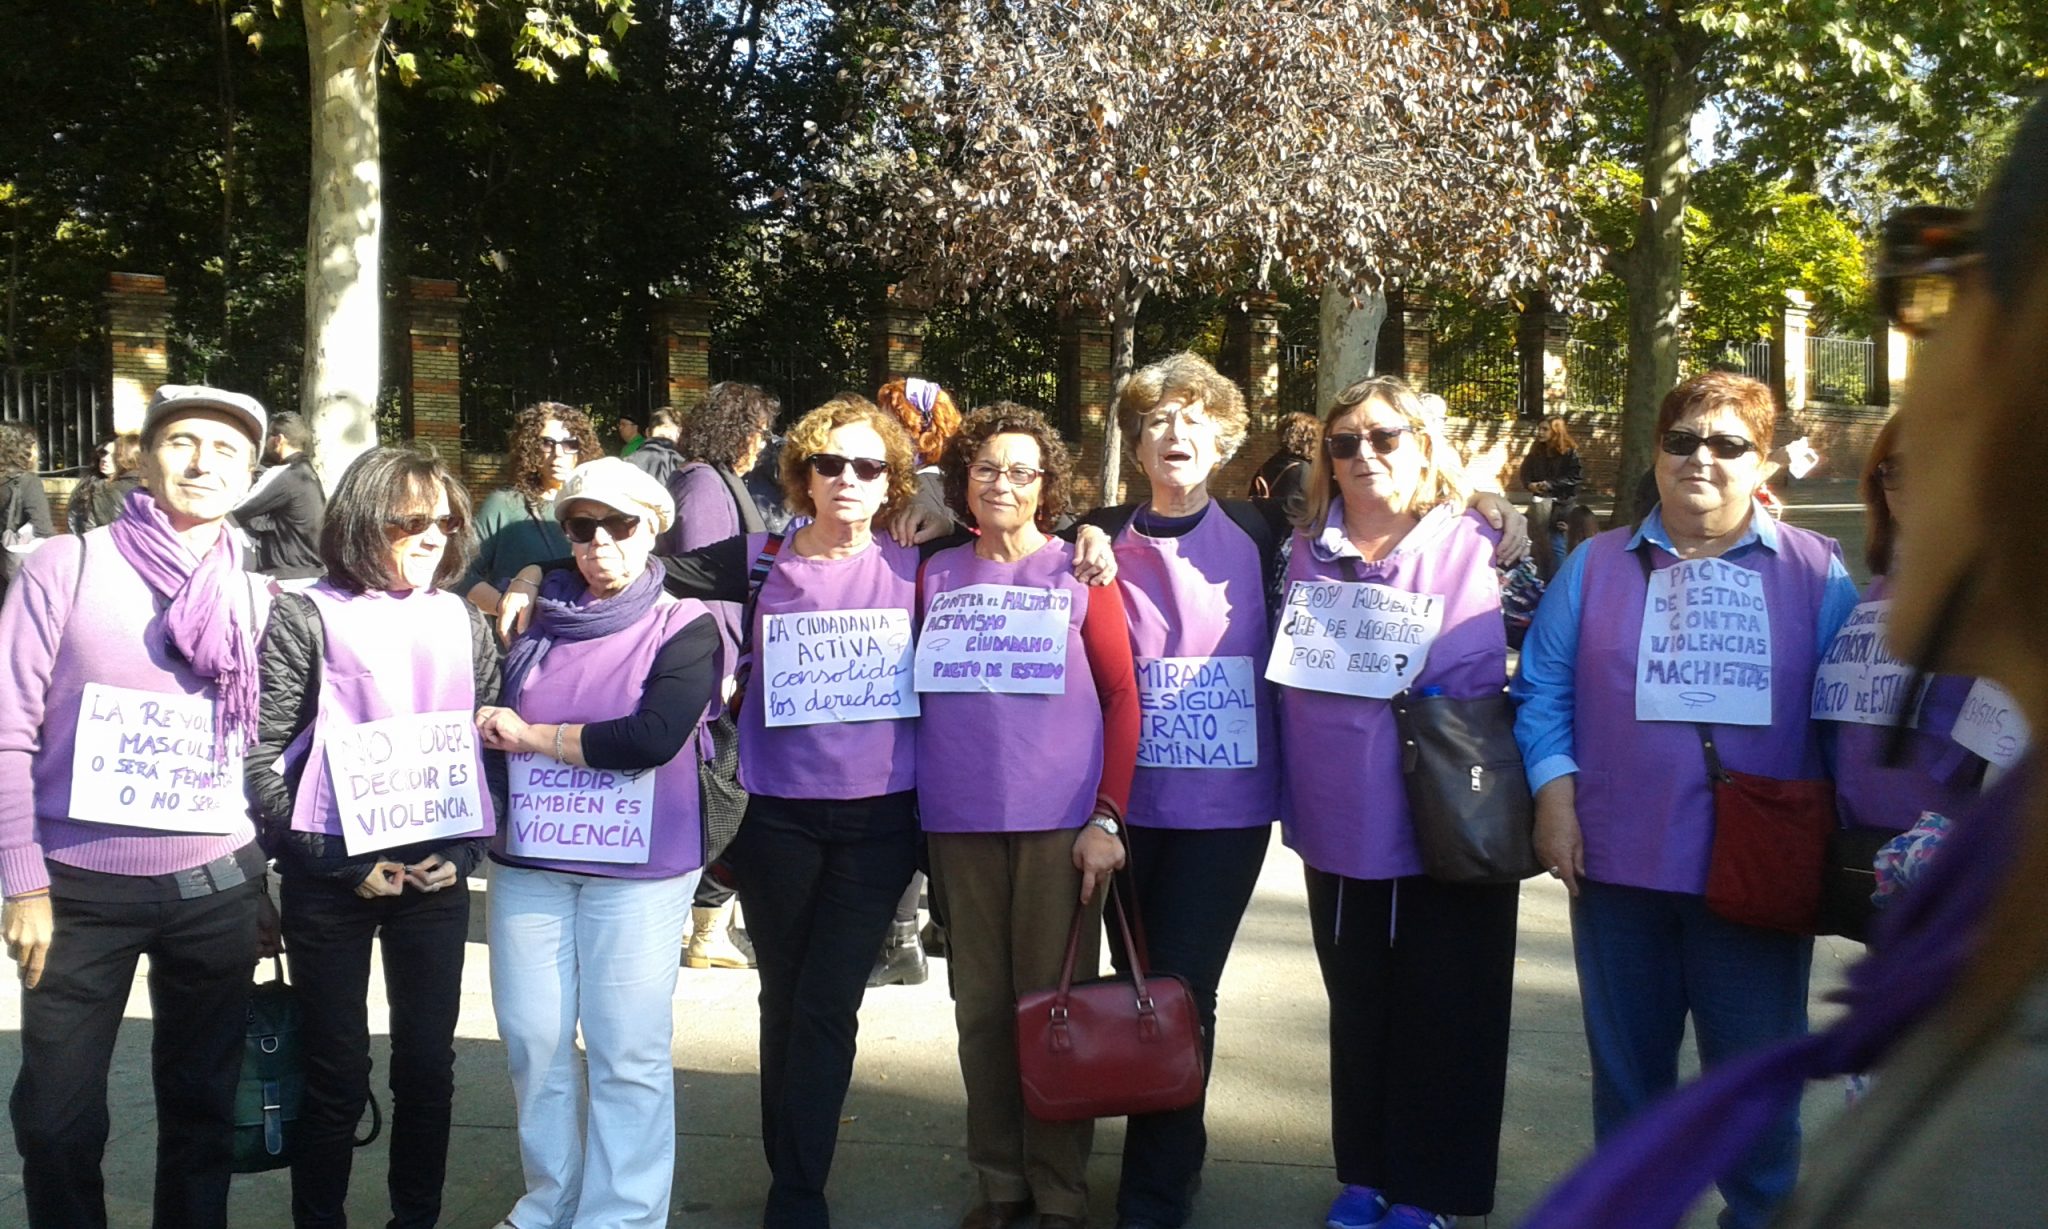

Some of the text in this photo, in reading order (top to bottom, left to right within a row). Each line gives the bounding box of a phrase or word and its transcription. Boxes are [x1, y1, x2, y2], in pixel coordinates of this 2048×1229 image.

[1670, 560, 1751, 588] PACTO
[931, 592, 983, 613] CONTRA
[1655, 586, 1765, 613] DE ESTADO
[768, 615, 790, 643] LA
[1323, 618, 1347, 638] DE
[1355, 617, 1425, 645] MORIR
[1669, 609, 1761, 632] CONTRA
[798, 635, 883, 666] ACTIVA
[1651, 633, 1767, 655] VIOLENCIAS
[771, 657, 908, 689] consolida
[933, 660, 1065, 680] PACTO DE ESTADO
[1137, 660, 1229, 689] MIRADA
[1290, 646, 1409, 677] POR ELLO?
[1645, 659, 1770, 692] MACHISTAS
[769, 681, 901, 718] los derechos
[1140, 689, 1256, 712] ESIGUAL
[1813, 677, 1849, 713] PACTO
[1854, 691, 1870, 713] DE
[90, 693, 209, 733] LA REVOL
[1140, 713, 1218, 741] TRATO
[91, 755, 105, 772] O
[1136, 738, 1253, 767] RIMINAL
[449, 764, 468, 787] ES
[119, 785, 220, 812] O NO SER
[356, 797, 474, 836] VIOLENCIA.
